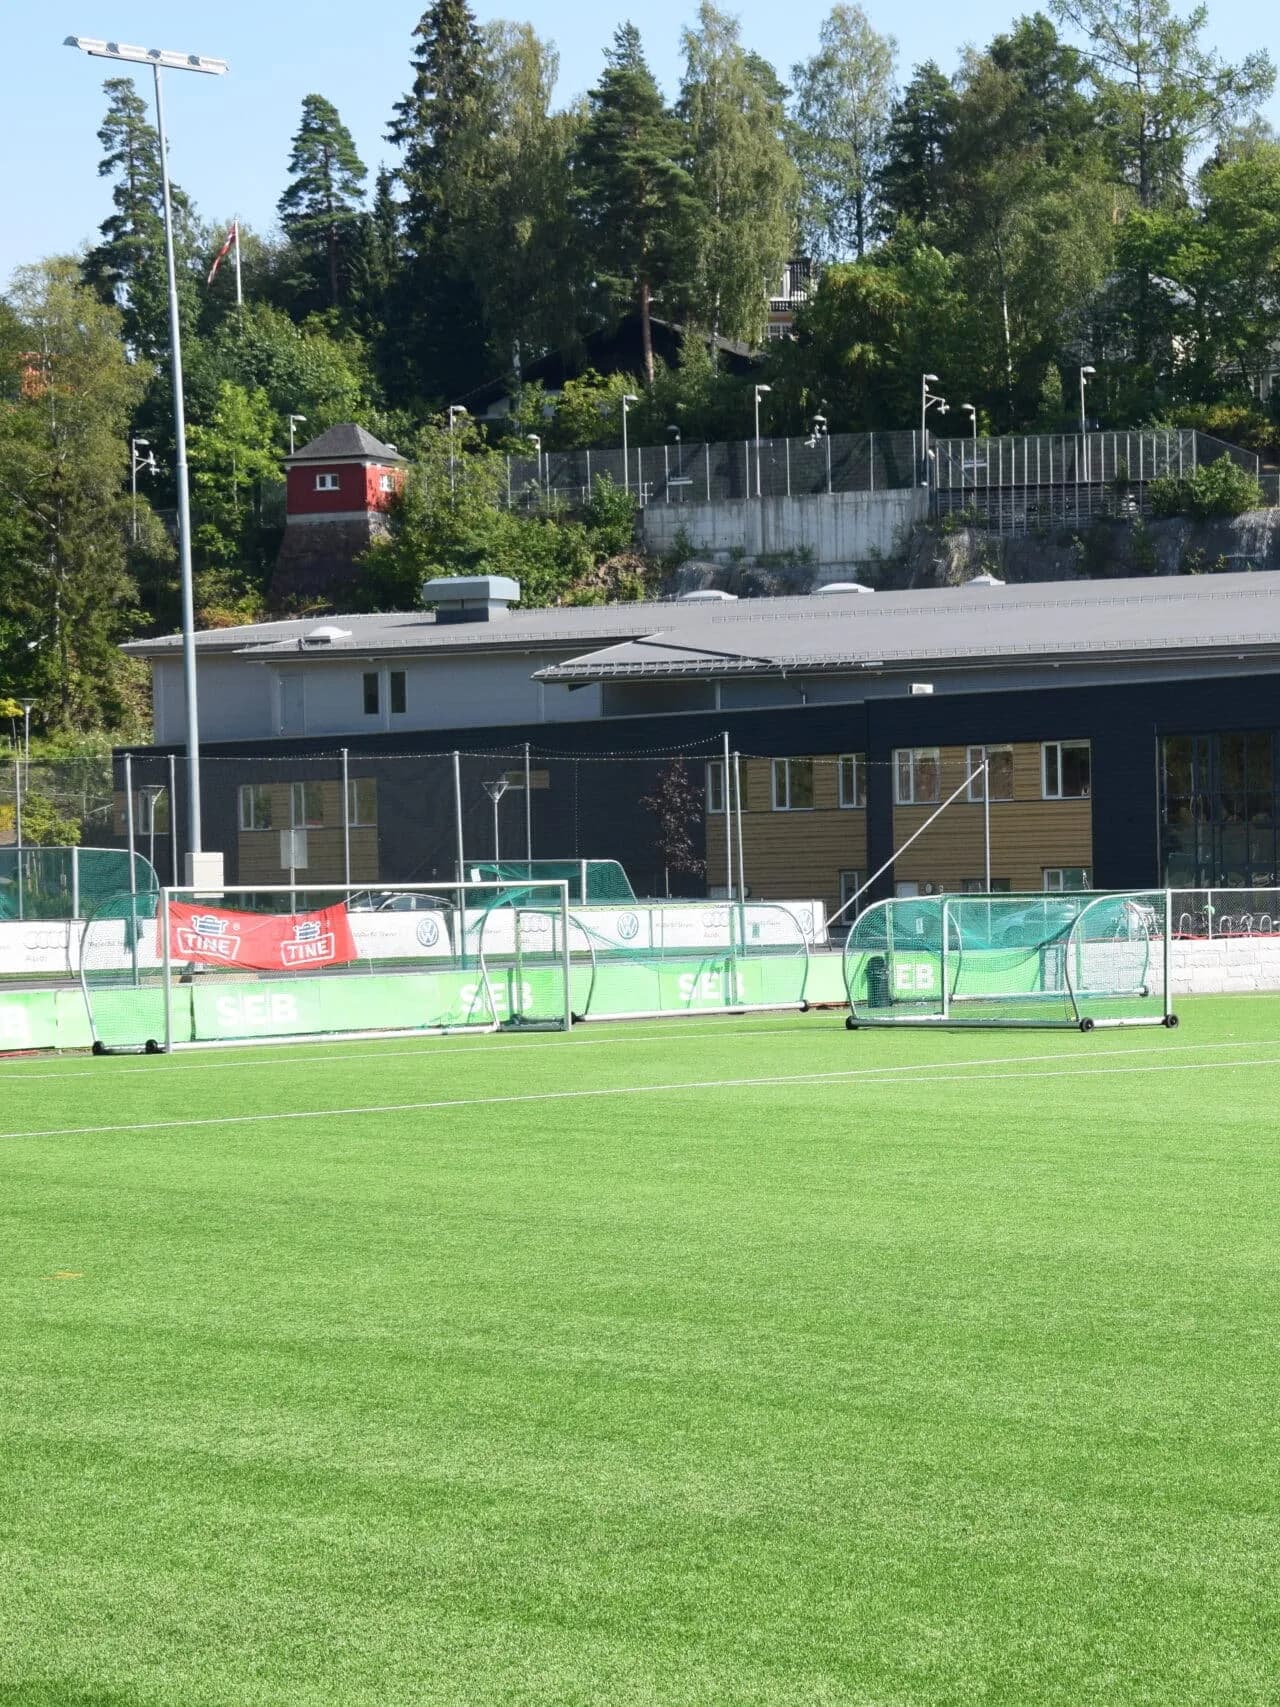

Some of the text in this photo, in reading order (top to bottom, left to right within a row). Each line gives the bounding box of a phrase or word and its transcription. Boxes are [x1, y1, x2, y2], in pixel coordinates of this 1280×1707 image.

[184, 934, 231, 954] TINE
[286, 942, 329, 960] TINE
[217, 993, 298, 1026] SEB
